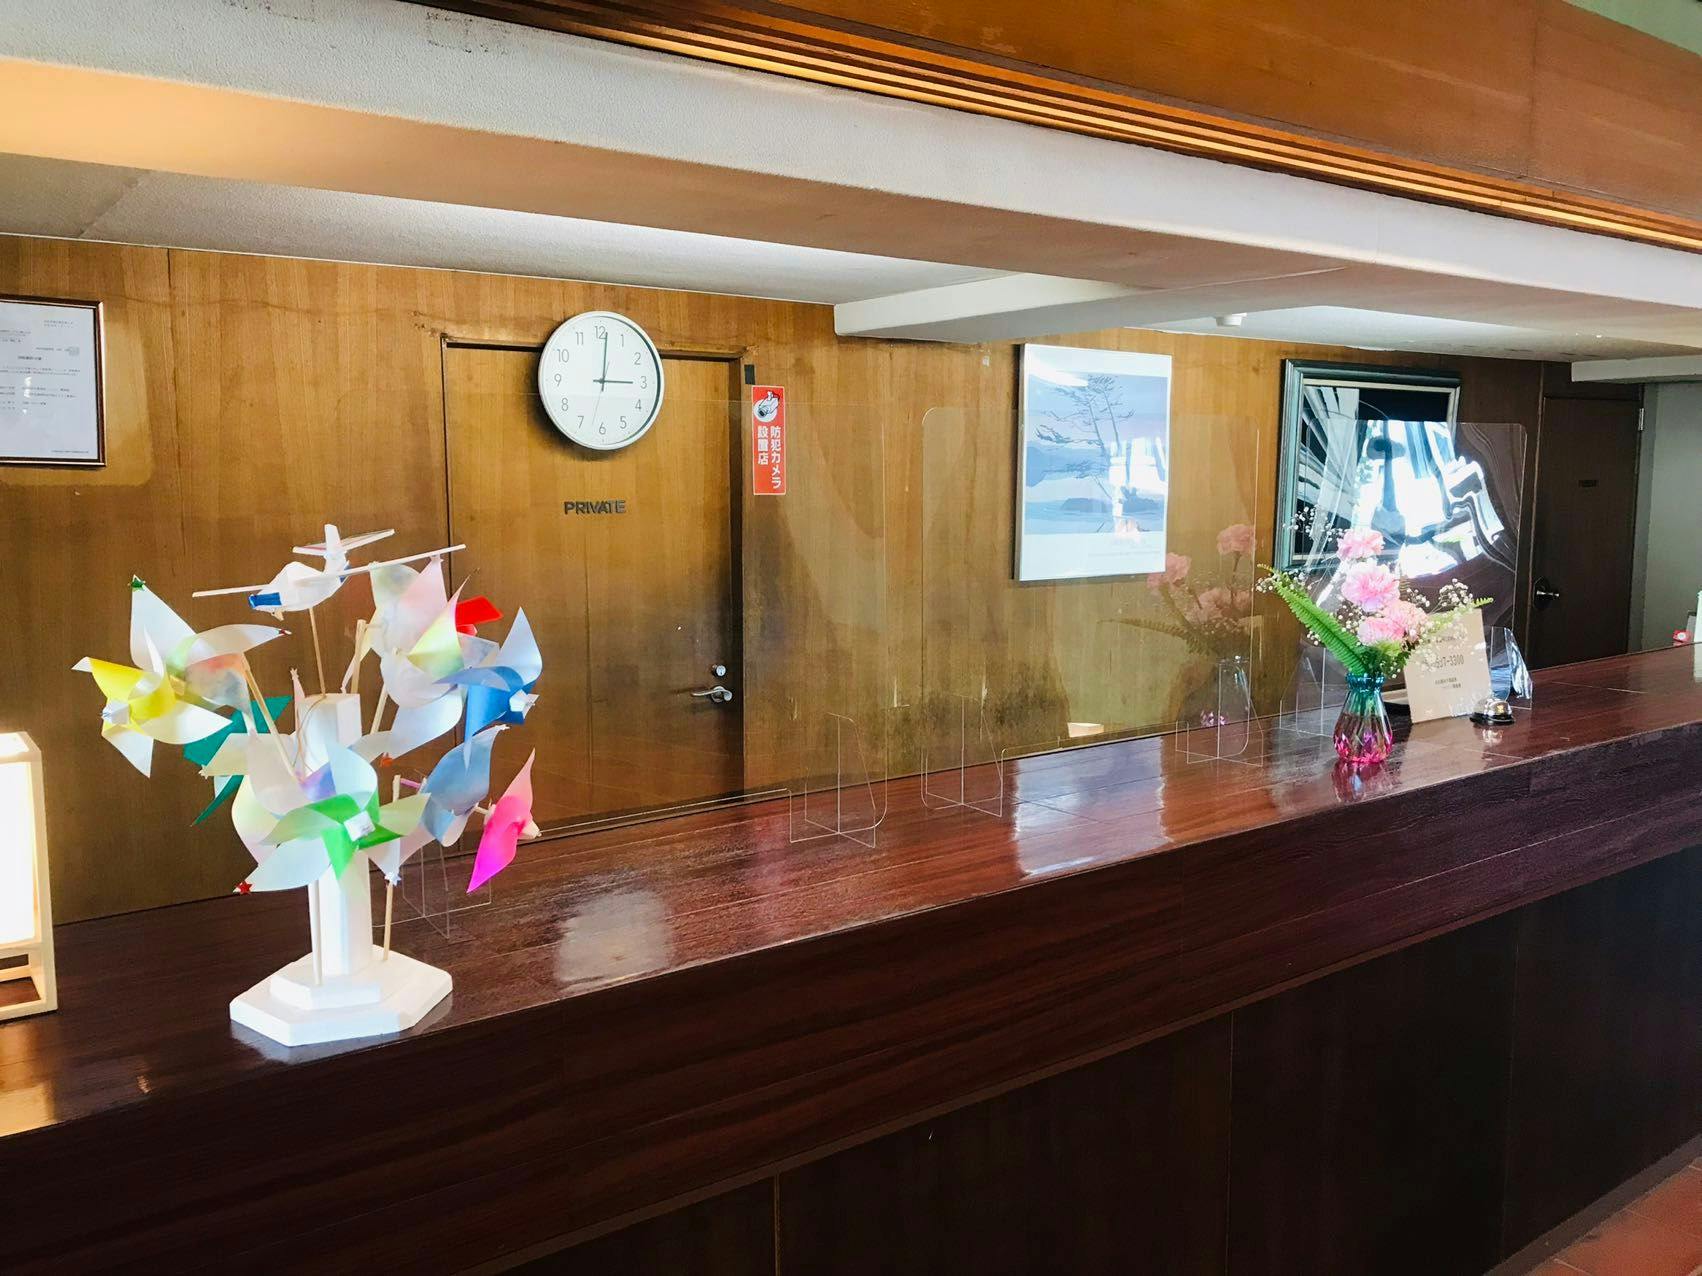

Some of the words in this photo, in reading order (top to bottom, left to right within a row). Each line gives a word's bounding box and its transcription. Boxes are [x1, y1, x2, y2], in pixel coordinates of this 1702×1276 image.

[575, 331, 584, 346] 11
[594, 325, 607, 340] 12
[556, 348, 570, 363] 10
[633, 352, 642, 366] 2
[553, 373, 562, 387] 9
[640, 375, 648, 390] 3
[561, 397, 569, 412] 8
[634, 398, 642, 413] 4
[577, 415, 585, 429] 7
[598, 421, 607, 435] 6
[619, 415, 627, 430] 5
[757, 425, 769, 465] 設置店
[770, 426, 782, 489] 防犯カメラ
[563, 499, 626, 515] PRIVATE
